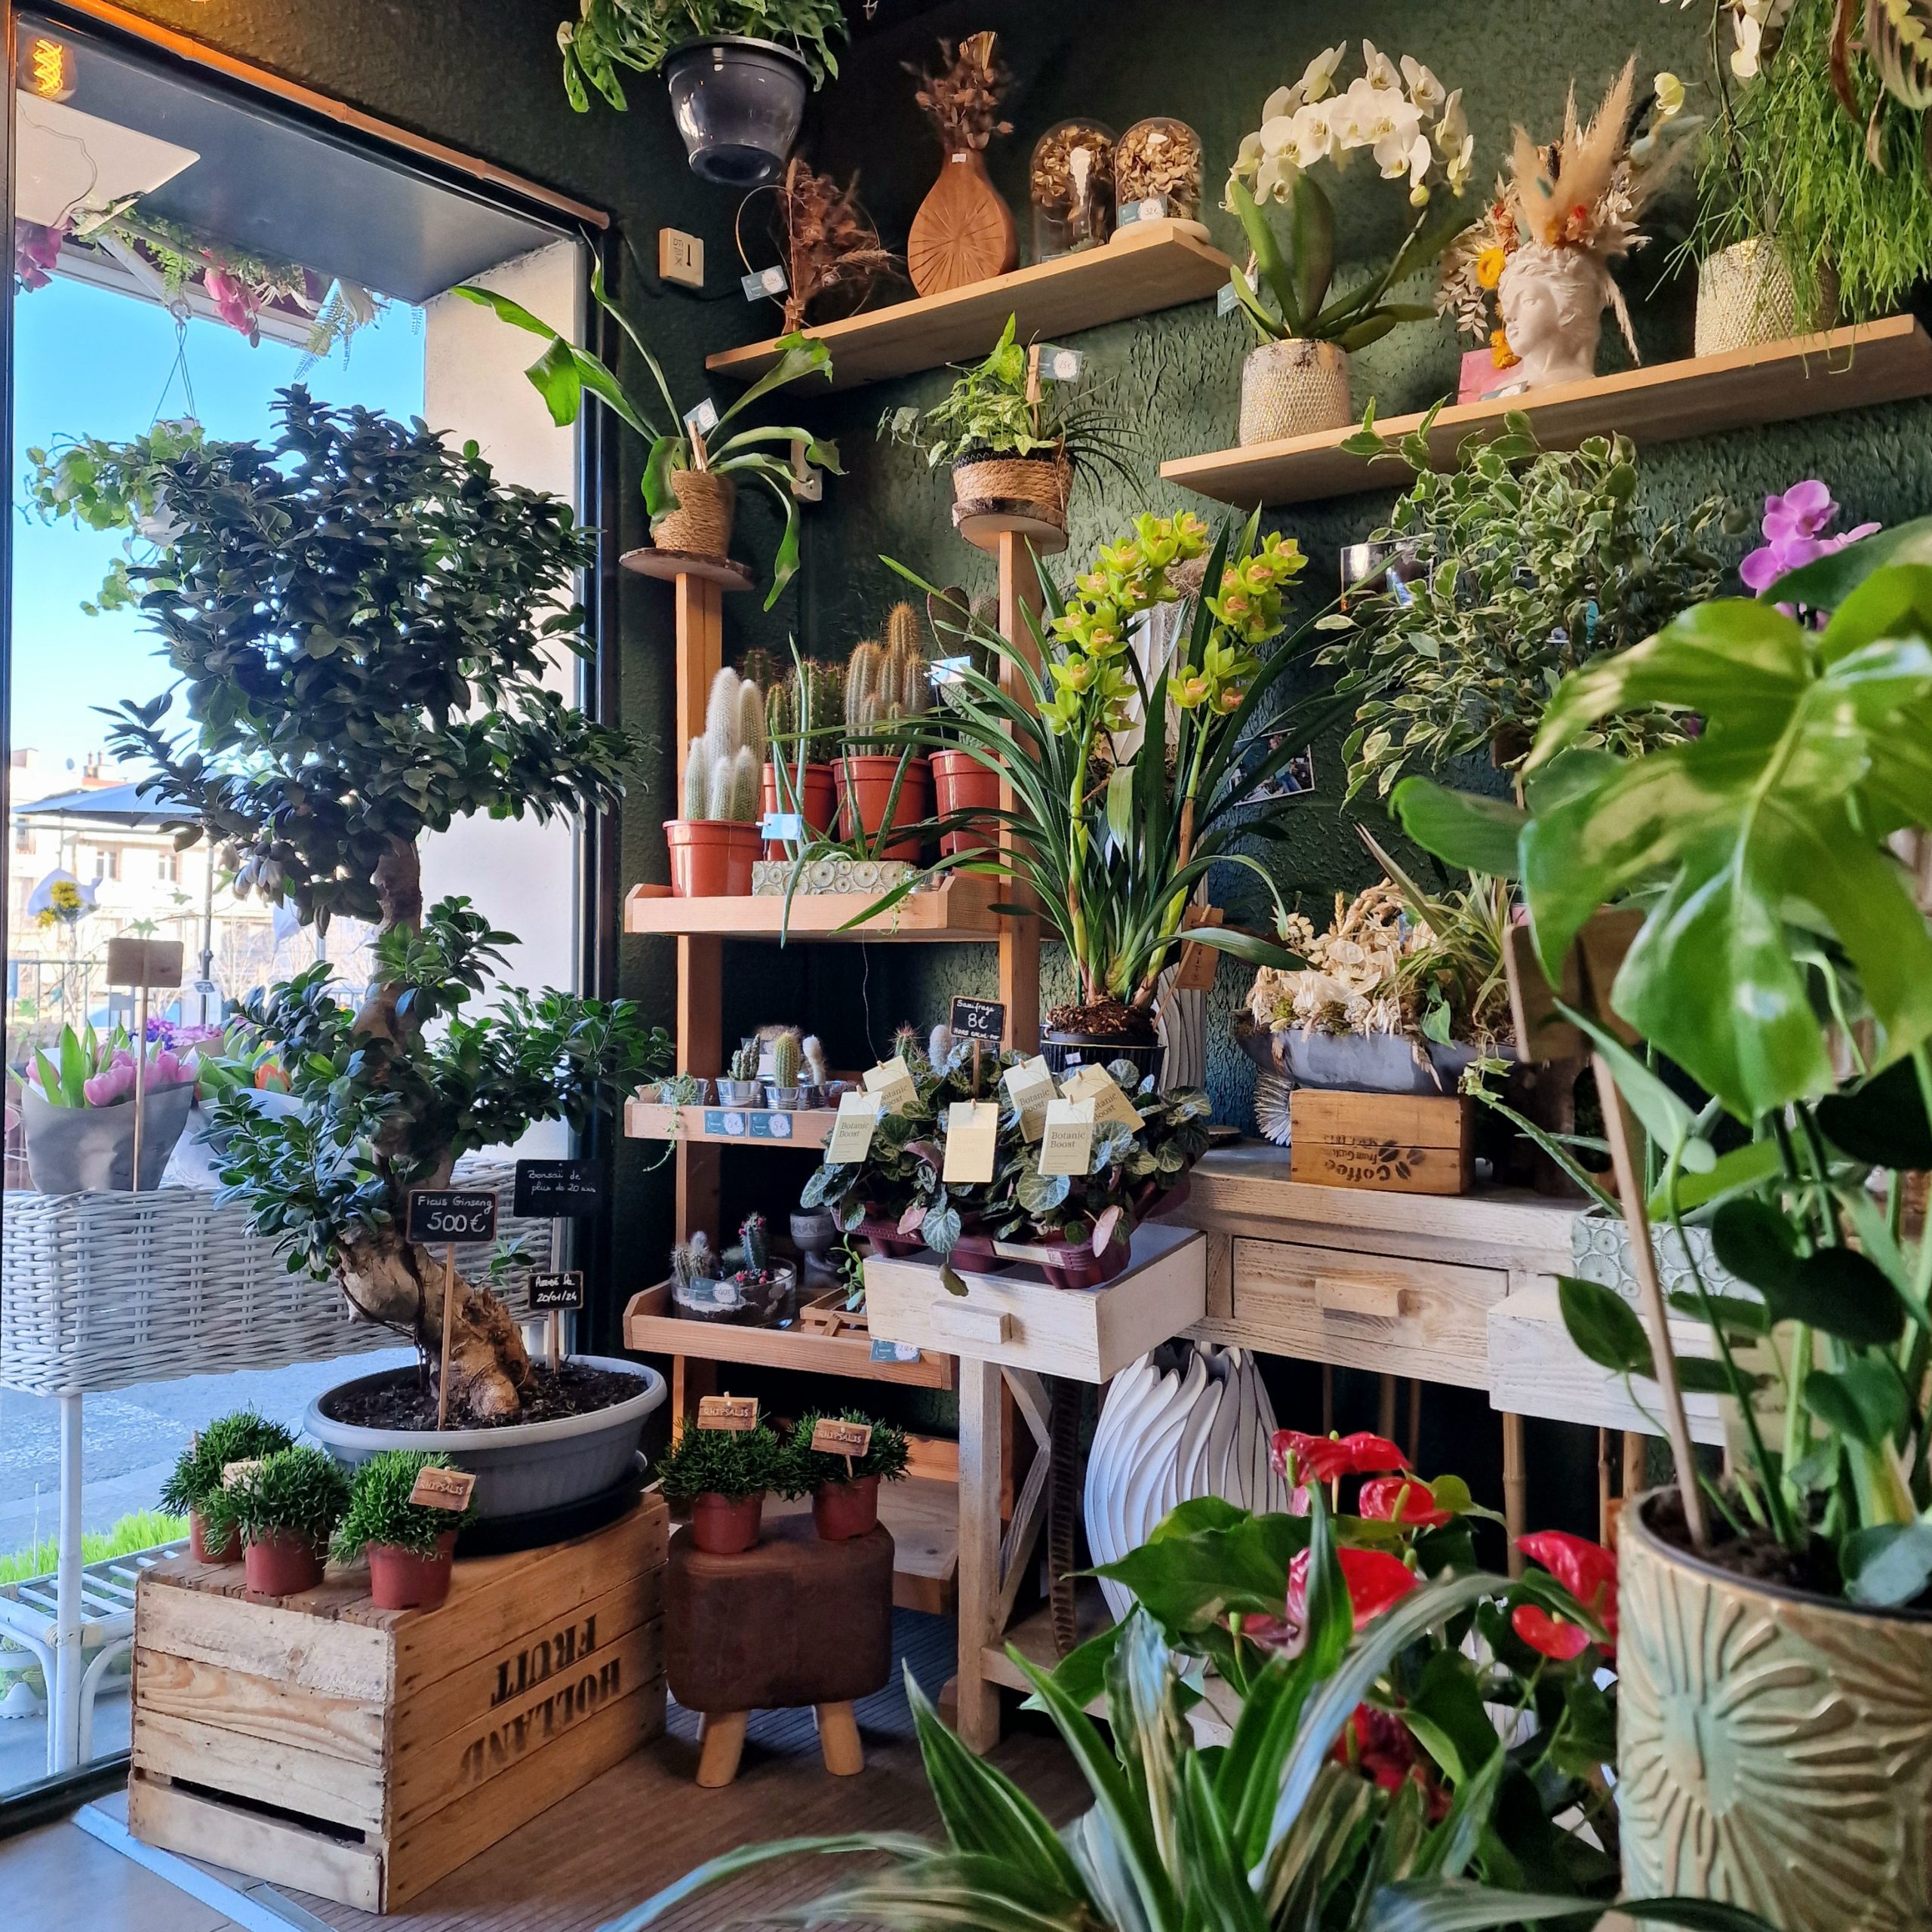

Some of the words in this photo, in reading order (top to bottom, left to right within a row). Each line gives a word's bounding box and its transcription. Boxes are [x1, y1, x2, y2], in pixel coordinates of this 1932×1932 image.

[968, 1013, 989, 1029] 8€
[881, 1084, 908, 1101] otanic
[1020, 1089, 1051, 1106] Botanic
[1023, 1100, 1046, 1115] Boost
[1094, 1091, 1118, 1112] otanic
[773, 1121, 785, 1131] 5€
[839, 1130, 860, 1138] Boost
[1051, 1131, 1085, 1140] Botanic
[1051, 1140, 1075, 1149] Boost
[569, 1169, 582, 1180] de
[1324, 1159, 1391, 1182] Coffee
[531, 1181, 552, 1195] plus
[555, 1182, 565, 1192] de
[567, 1183, 580, 1192] 20
[417, 1195, 448, 1206] Ficus
[453, 1195, 494, 1215] Ginseng
[426, 1211, 486, 1232] 500€
[536, 1291, 577, 1303] 20/01/24
[703, 1407, 749, 1417] RHIPSALIS
[818, 1430, 862, 1444] RHIPSALIS
[419, 1479, 464, 1496] RHIPSALIS
[491, 1613, 596, 1708] FRUIT
[460, 1657, 622, 1781] HOLLAND
